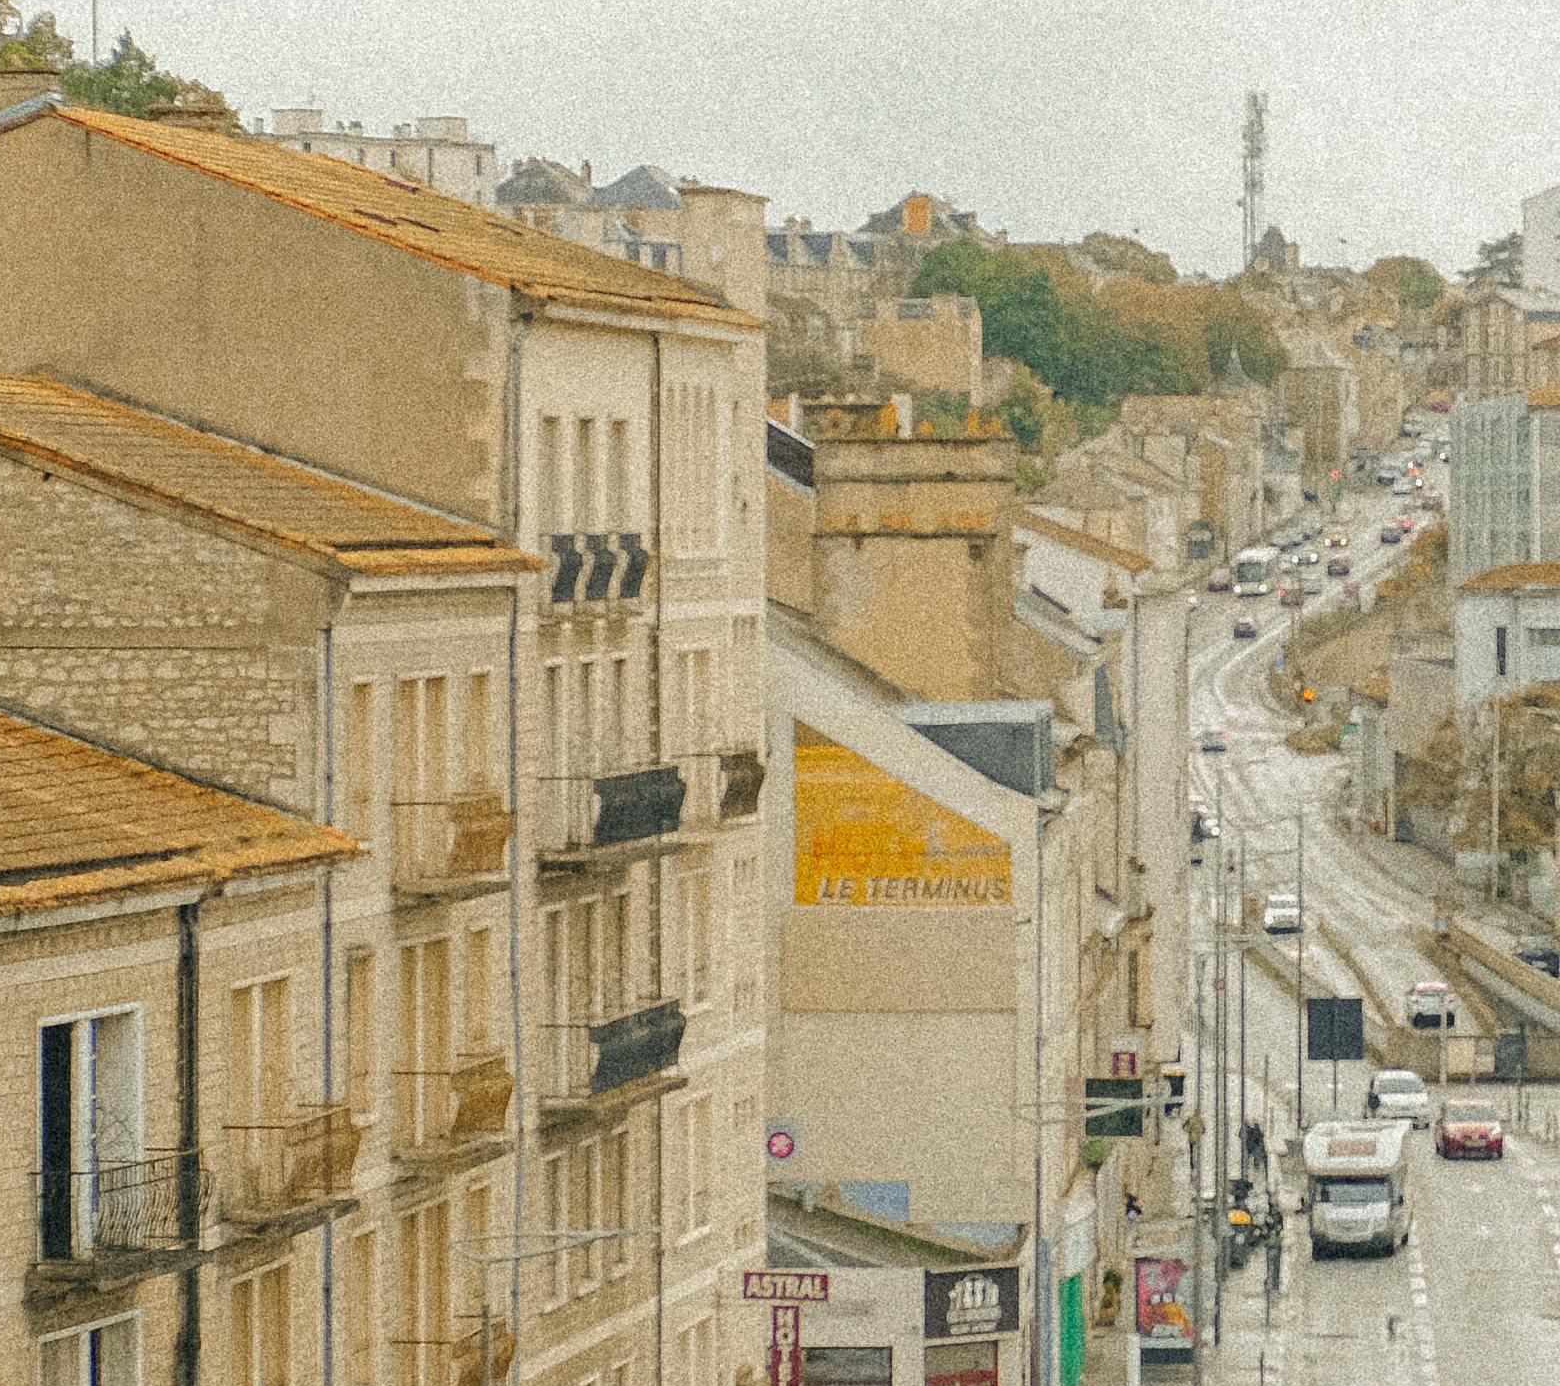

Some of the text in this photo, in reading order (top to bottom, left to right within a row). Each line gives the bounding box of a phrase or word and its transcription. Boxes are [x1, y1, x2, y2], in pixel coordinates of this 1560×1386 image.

[822, 876, 1007, 900] LE TERMINUS
[745, 1274, 826, 1300] ASTRAL
